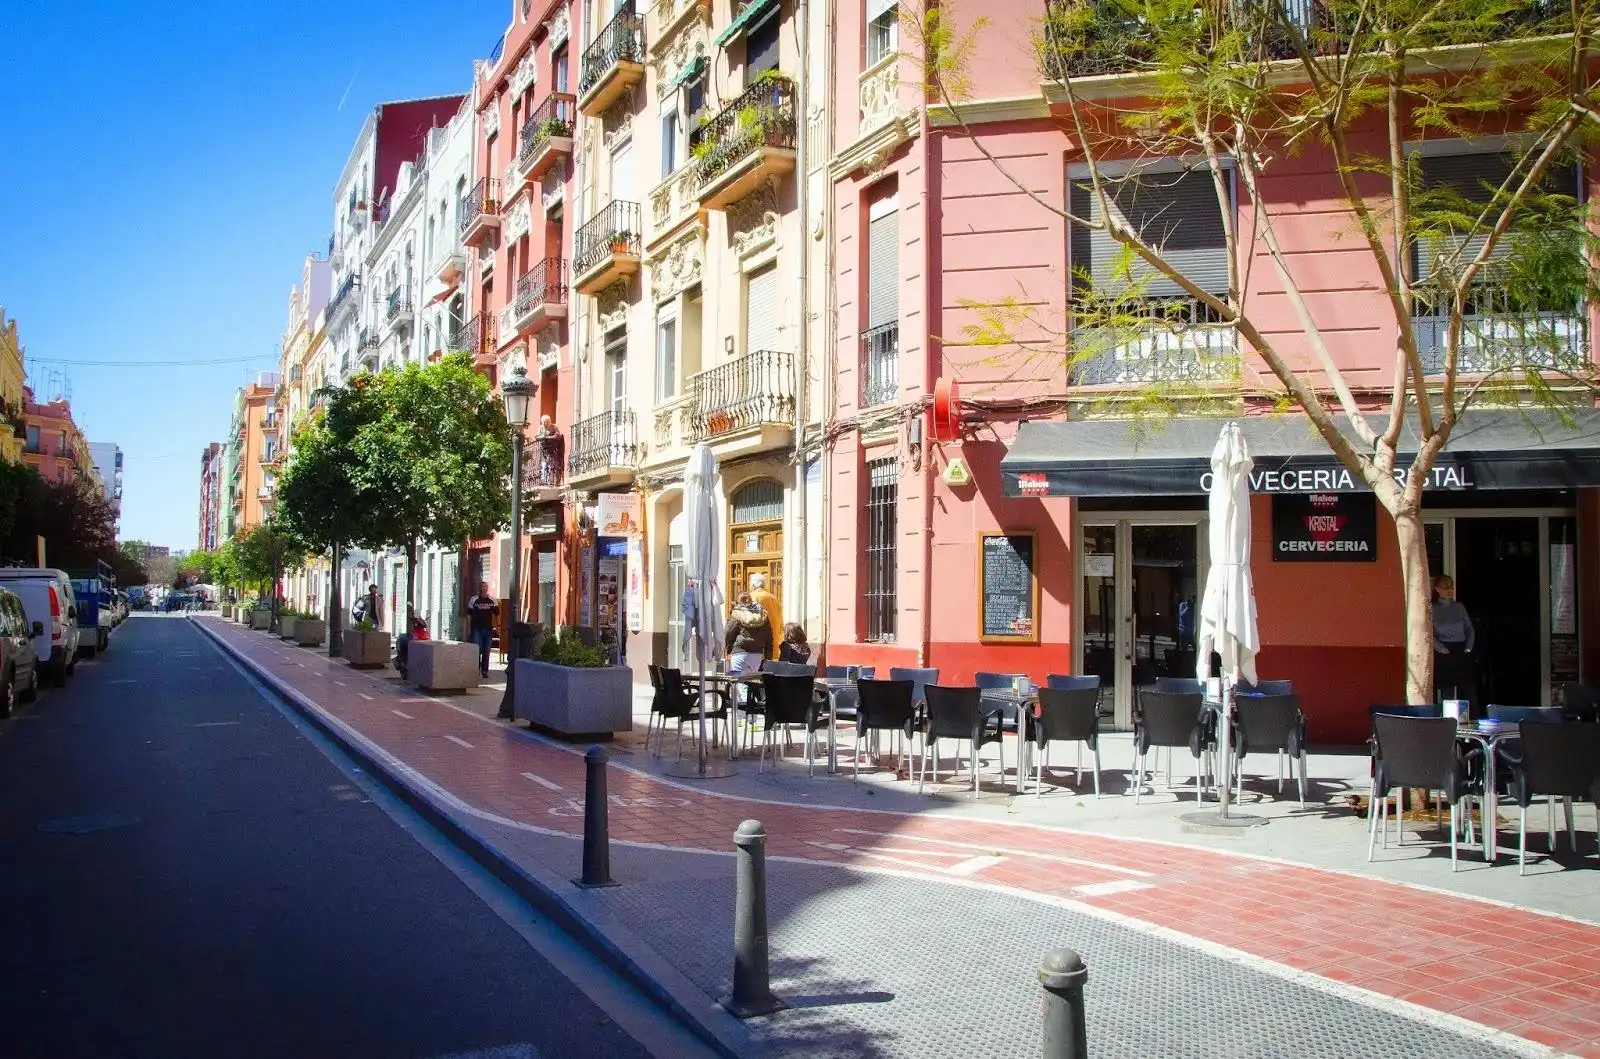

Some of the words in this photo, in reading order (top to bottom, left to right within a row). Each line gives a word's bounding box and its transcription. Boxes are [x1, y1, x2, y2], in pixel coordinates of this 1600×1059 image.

[1200, 470, 1354, 492] CVECERIA
[1392, 466, 1474, 488] RTAL
[1309, 494, 1339, 503] Mahou
[1308, 515, 1340, 532] KRISTAL
[1279, 541, 1369, 551] CERVECERIA
